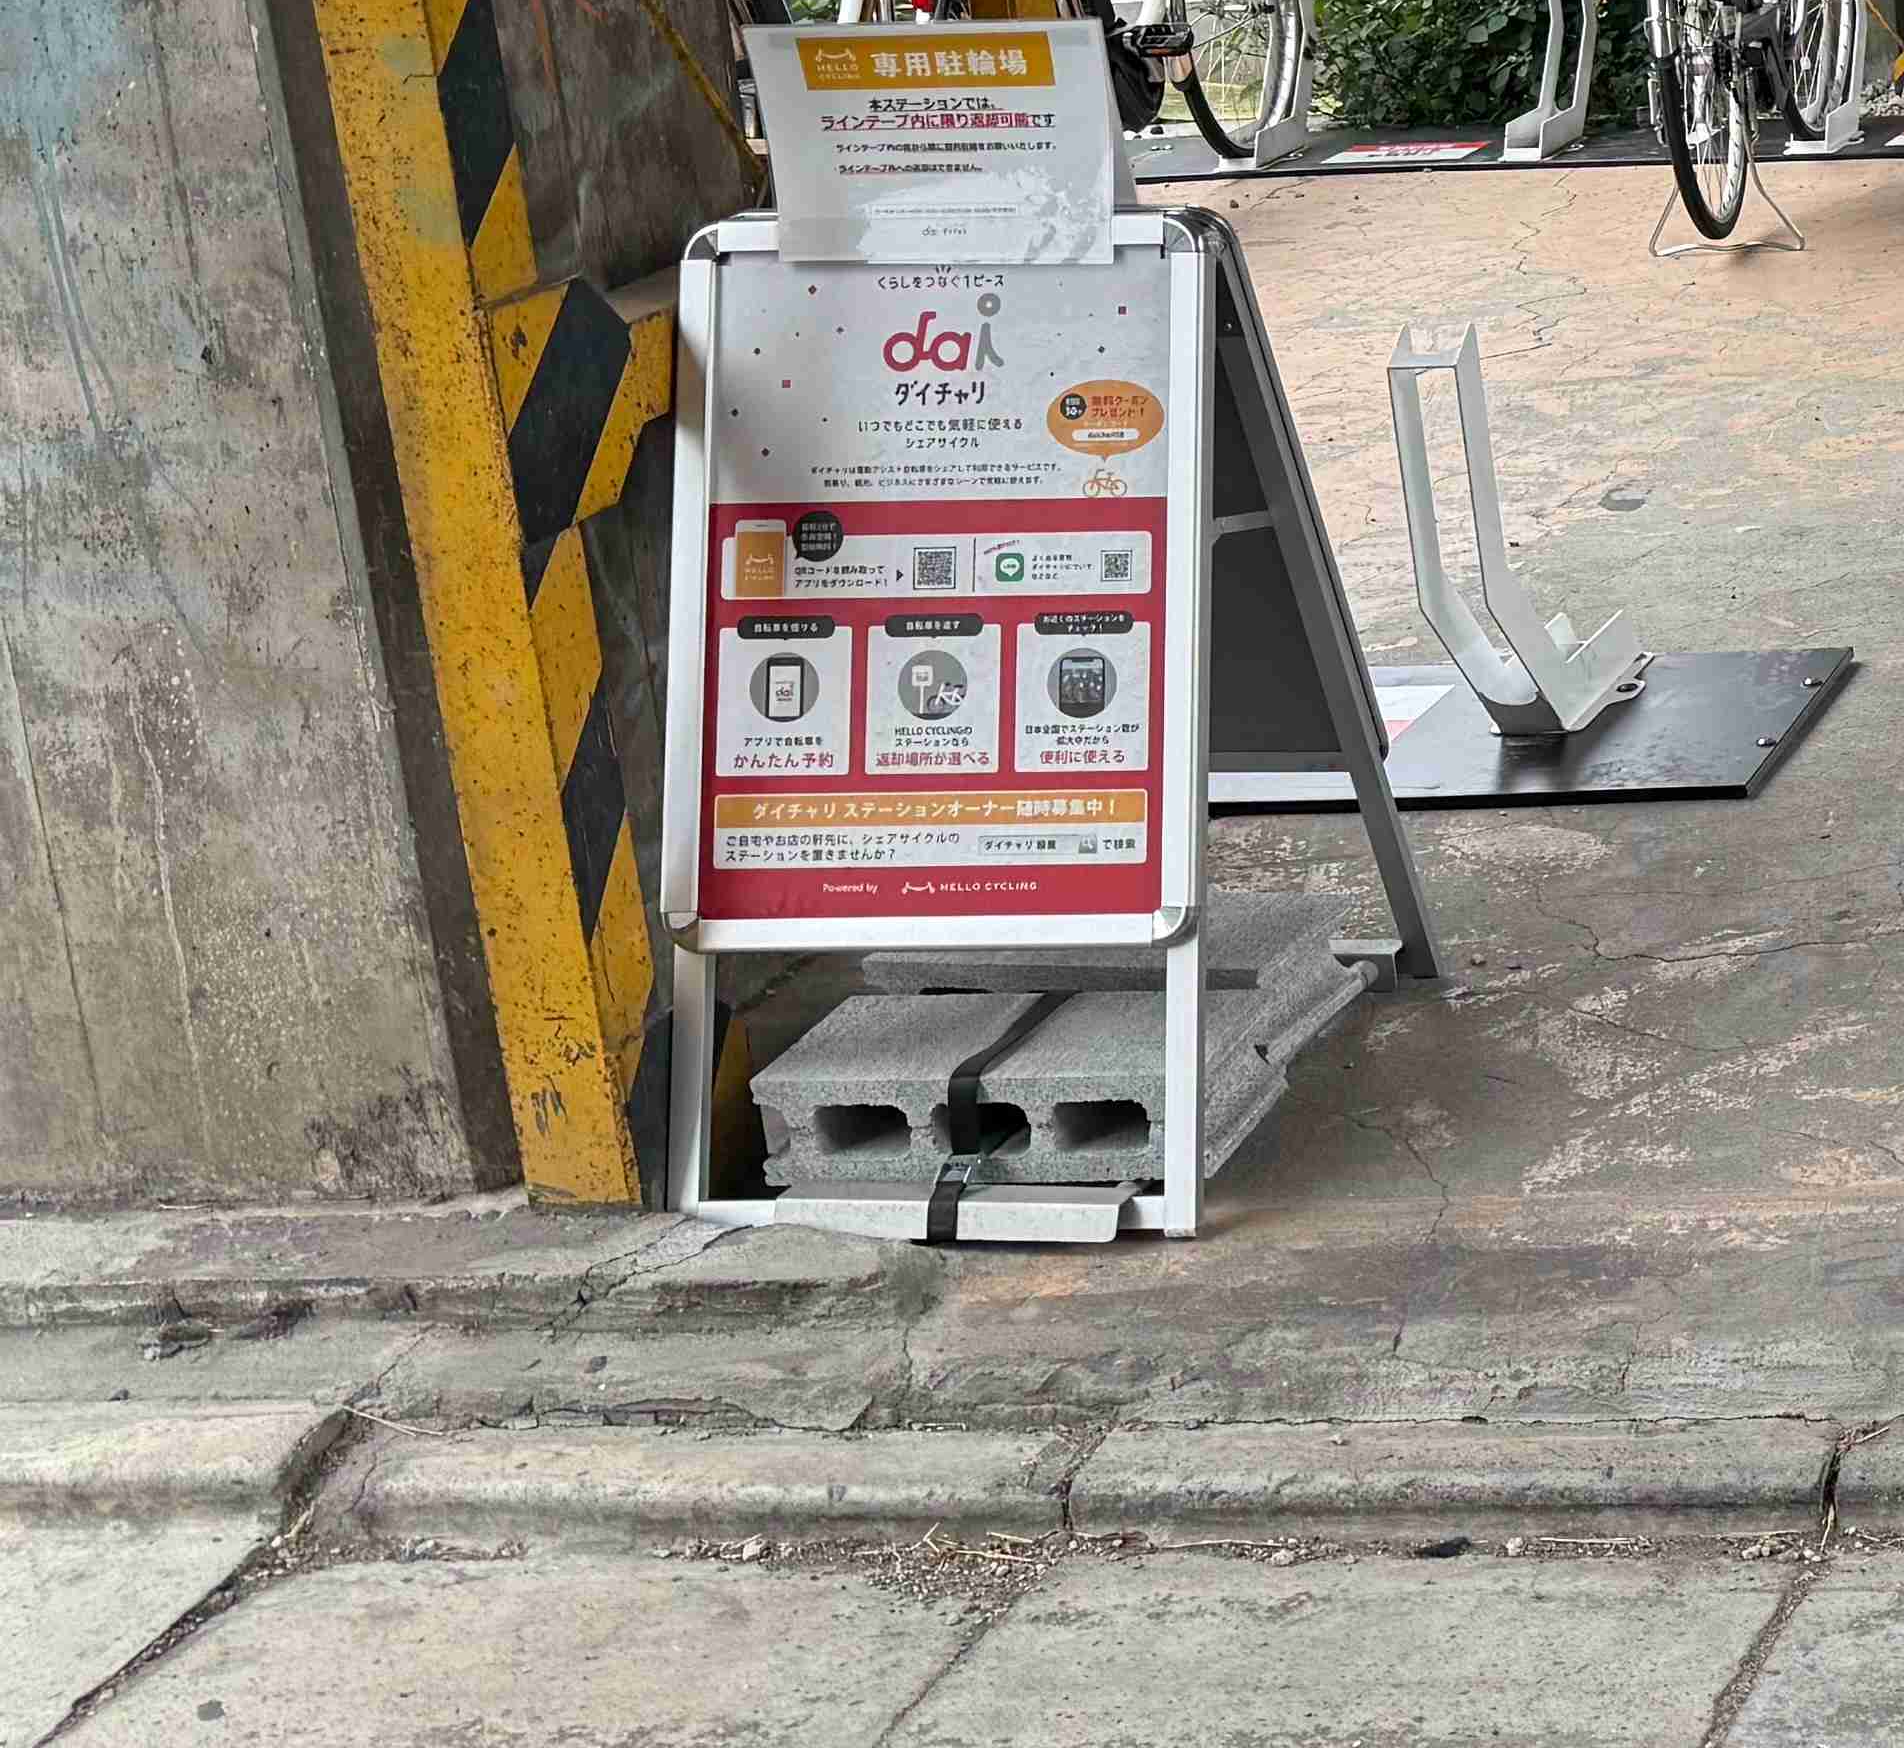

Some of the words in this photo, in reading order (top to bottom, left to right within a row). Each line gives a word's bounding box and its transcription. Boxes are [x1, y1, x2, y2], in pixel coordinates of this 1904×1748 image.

[869, 48, 1028, 78] 専用駐輪場
[883, 293, 1005, 372] dai
[894, 381, 986, 406] ダイチャリ
[858, 418, 1023, 433] いつでもどこでも気軽に使える
[905, 436, 980, 450] シェアサイクル
[734, 751, 833, 769] かんたん予約
[1040, 749, 1127, 764] 便利に使える
[752, 801, 836, 820] ダイチャリ
[983, 838, 1034, 851] ダイチャリ
[822, 883, 864, 893] Powered
[866, 883, 879, 894] by
[939, 882, 981, 892] HELLO
[984, 882, 1038, 891] CYCLING
